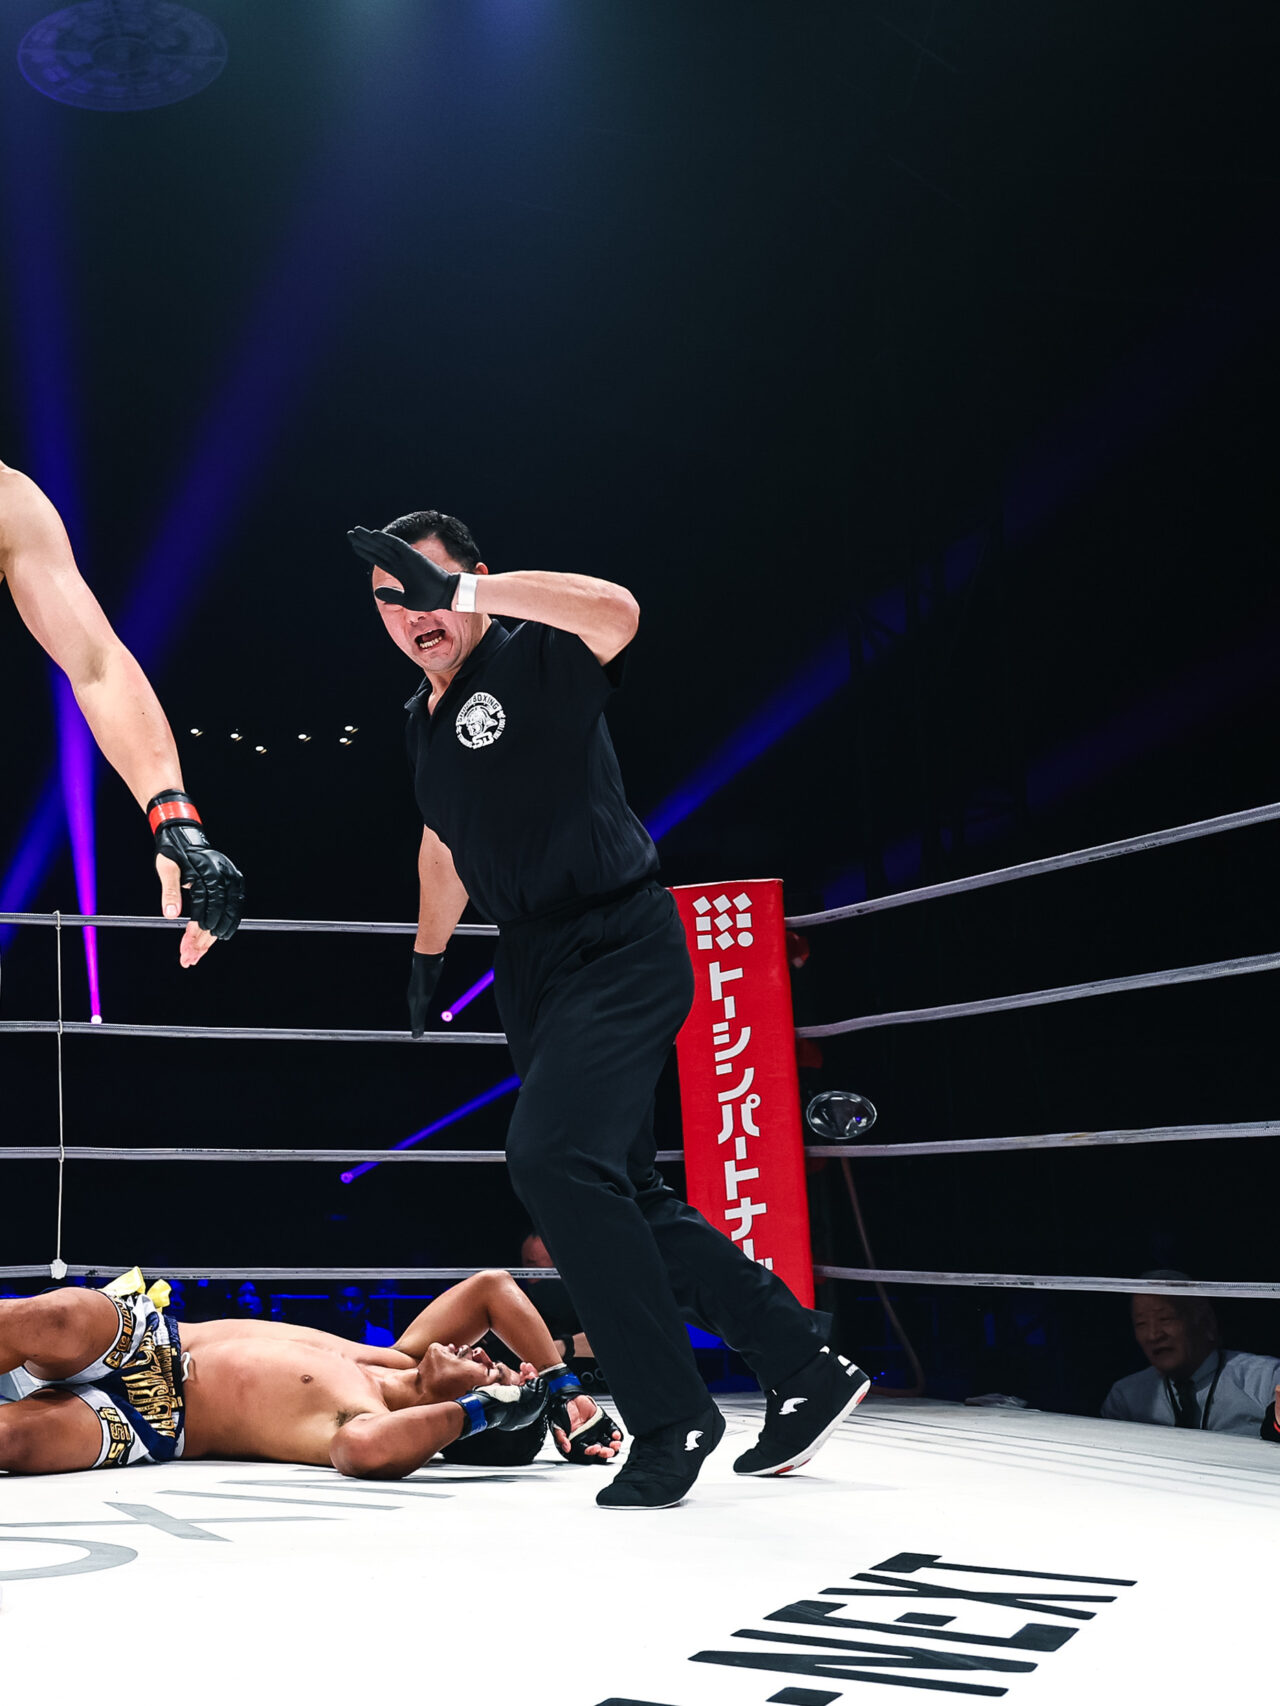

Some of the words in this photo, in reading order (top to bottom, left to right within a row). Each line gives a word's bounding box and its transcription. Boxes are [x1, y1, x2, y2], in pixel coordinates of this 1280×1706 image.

[708, 960, 773, 1271] トーシンパートナー
[593, 1552, 1139, 1706] -NEXT
